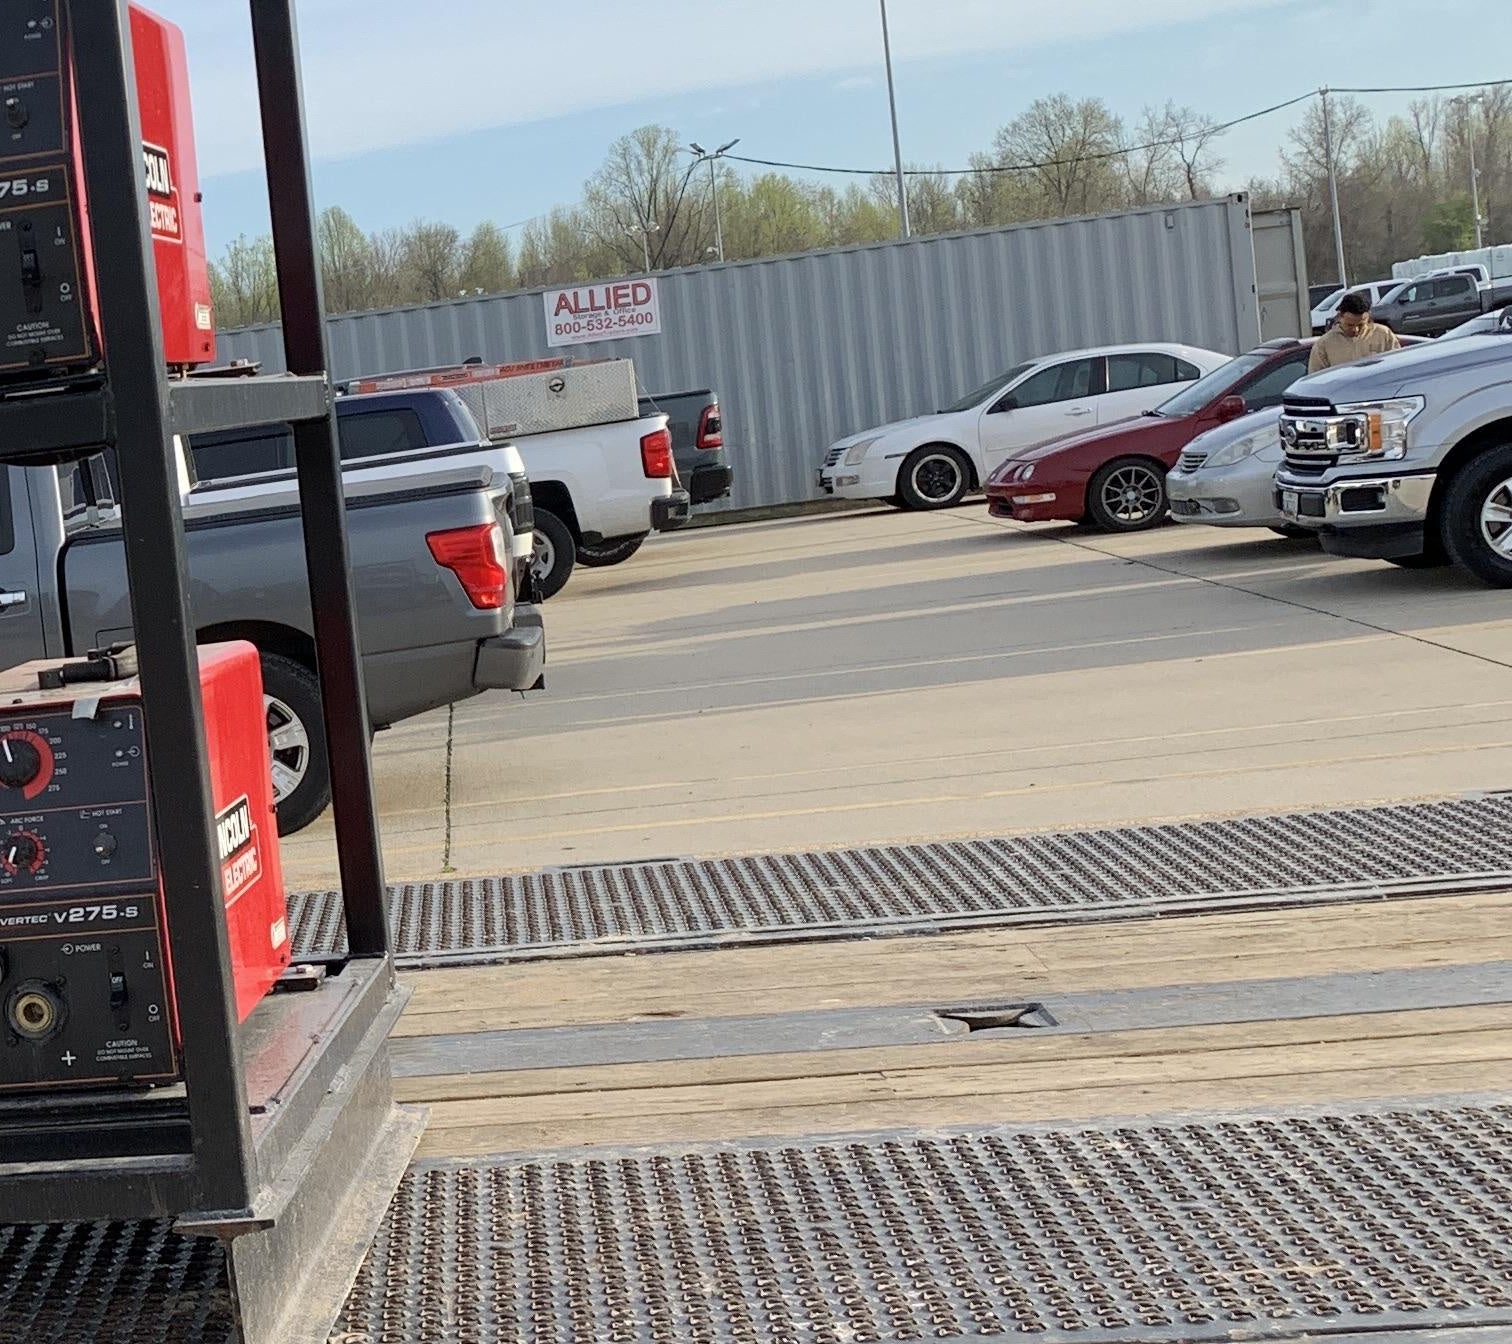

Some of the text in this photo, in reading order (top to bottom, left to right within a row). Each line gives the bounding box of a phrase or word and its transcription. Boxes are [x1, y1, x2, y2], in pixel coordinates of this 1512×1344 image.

[554, 282, 653, 317] ALLIED
[555, 312, 654, 335] 800-532-5400
[224, 847, 258, 897] ELECTRIC
[75, 944, 102, 952] POWER
[112, 976, 123, 984] OFF
[106, 1040, 138, 1048] CAUTION
